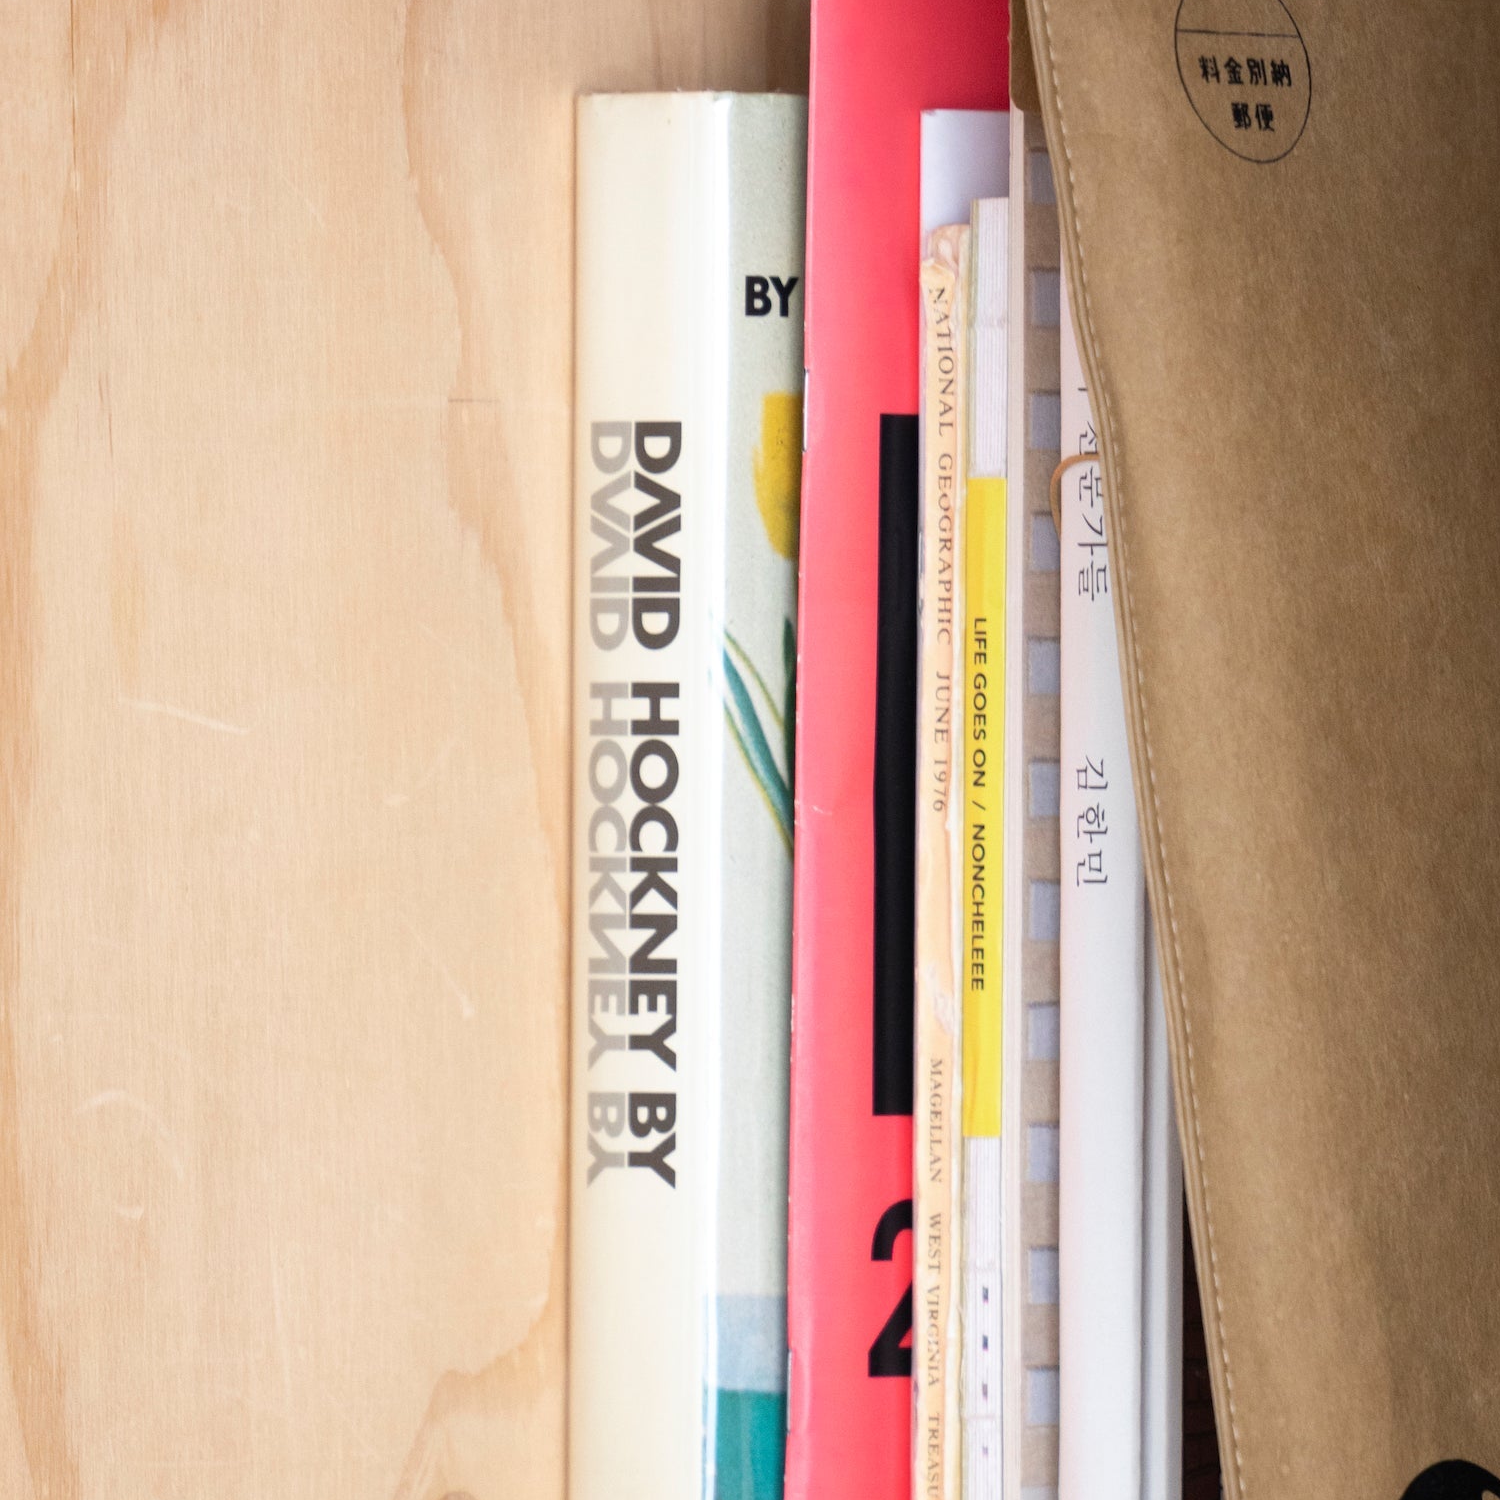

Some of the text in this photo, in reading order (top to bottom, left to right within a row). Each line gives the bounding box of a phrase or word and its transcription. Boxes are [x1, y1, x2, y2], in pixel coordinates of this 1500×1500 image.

[1199, 55, 1292, 87] 料金別納
[1231, 102, 1275, 132] 郵便
[744, 274, 800, 318] BY
[929, 286, 957, 814] NATIONAL GEOGRAPHIC JUNE 1976
[973, 616, 989, 667] LIFE
[972, 672, 988, 741] GOES
[972, 747, 987, 788] ON
[626, 421, 683, 1190] DAVID HOCKNEY BY
[1076, 756, 1109, 888] 김한민
[970, 823, 987, 992] NONCHELEEE
[928, 1057, 943, 1184] MAGELLAN
[926, 1212, 942, 1275] WEST
[925, 1283, 941, 1389] VIRGINIA
